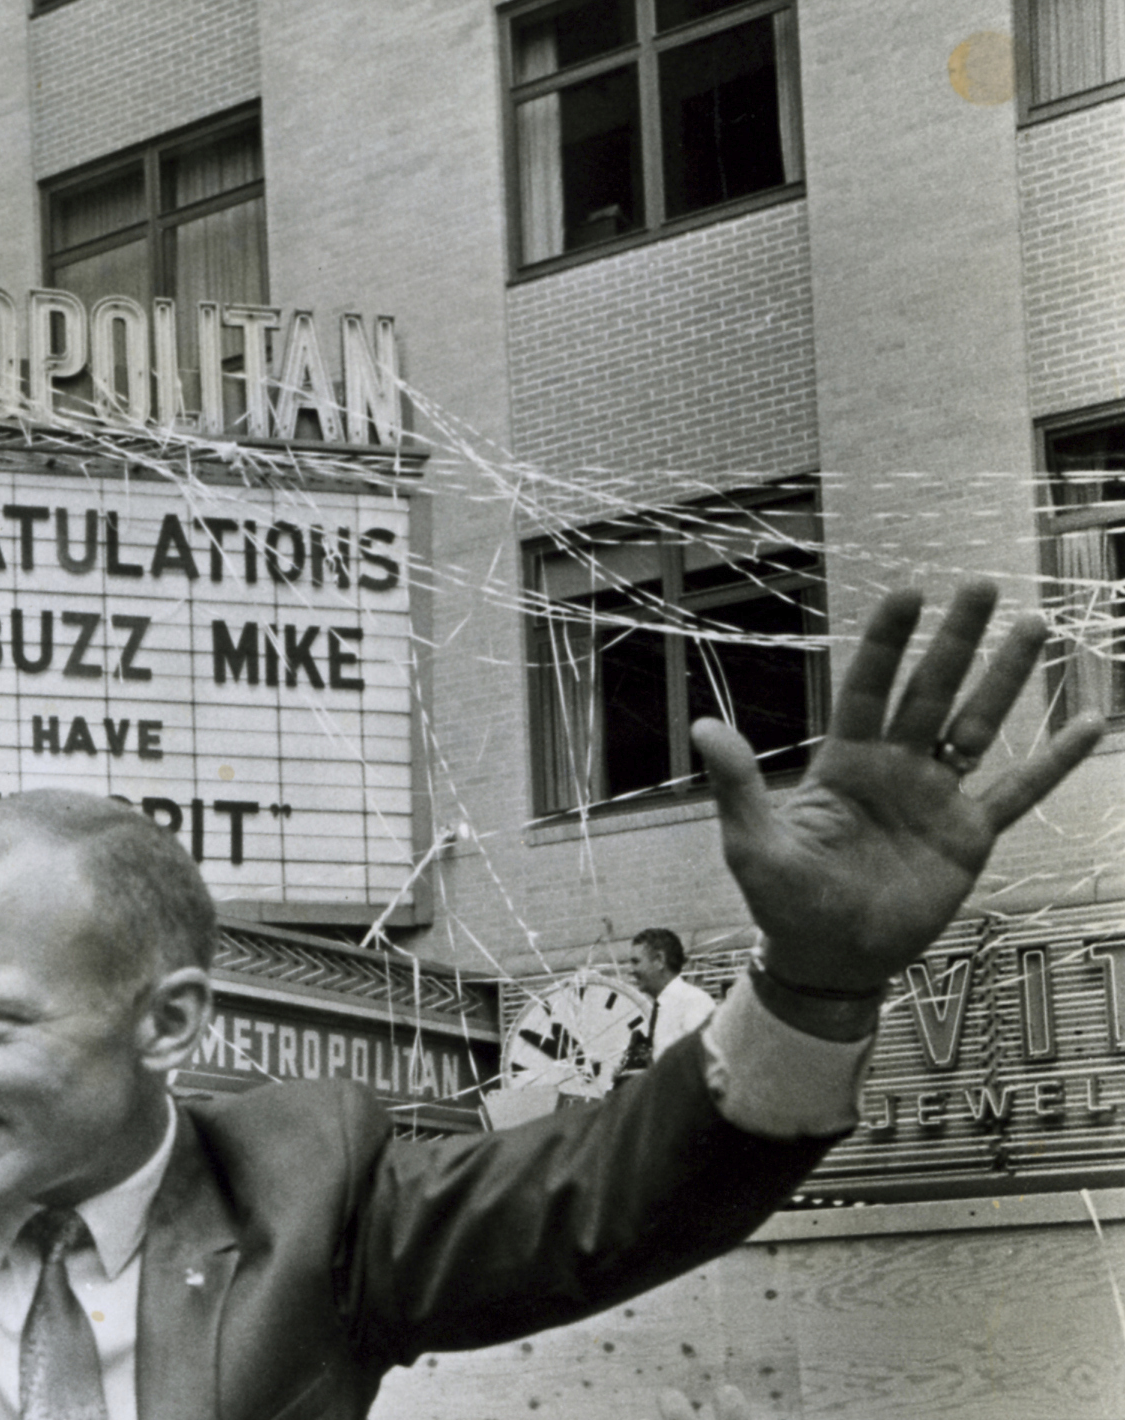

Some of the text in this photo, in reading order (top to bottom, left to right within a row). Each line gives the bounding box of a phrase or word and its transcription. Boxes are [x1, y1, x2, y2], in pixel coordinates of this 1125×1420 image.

[211, 620, 366, 692] MIKE
[32, 715, 164, 760] HAVE
[192, 1015, 460, 1100] METROPOLITAN
